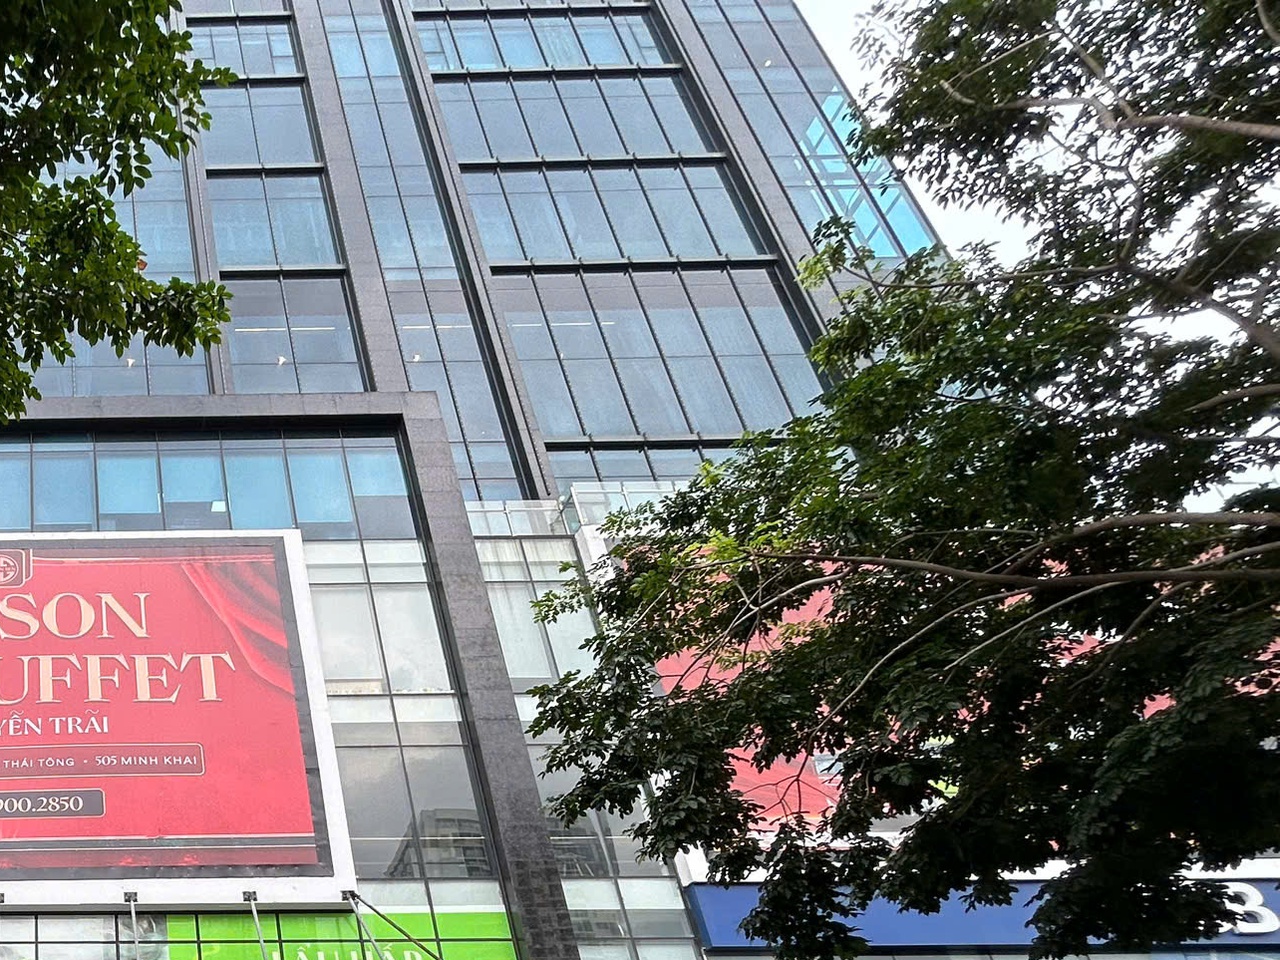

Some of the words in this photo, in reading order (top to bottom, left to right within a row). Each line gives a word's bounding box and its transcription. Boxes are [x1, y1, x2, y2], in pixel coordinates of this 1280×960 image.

[49, 709, 109, 735] TRÃI
[3, 757, 33, 769] THÁI
[38, 757, 75, 768] TÔNG
[94, 755, 118, 766] 505
[121, 756, 158, 766] MINH
[164, 755, 197, 766] KHAI
